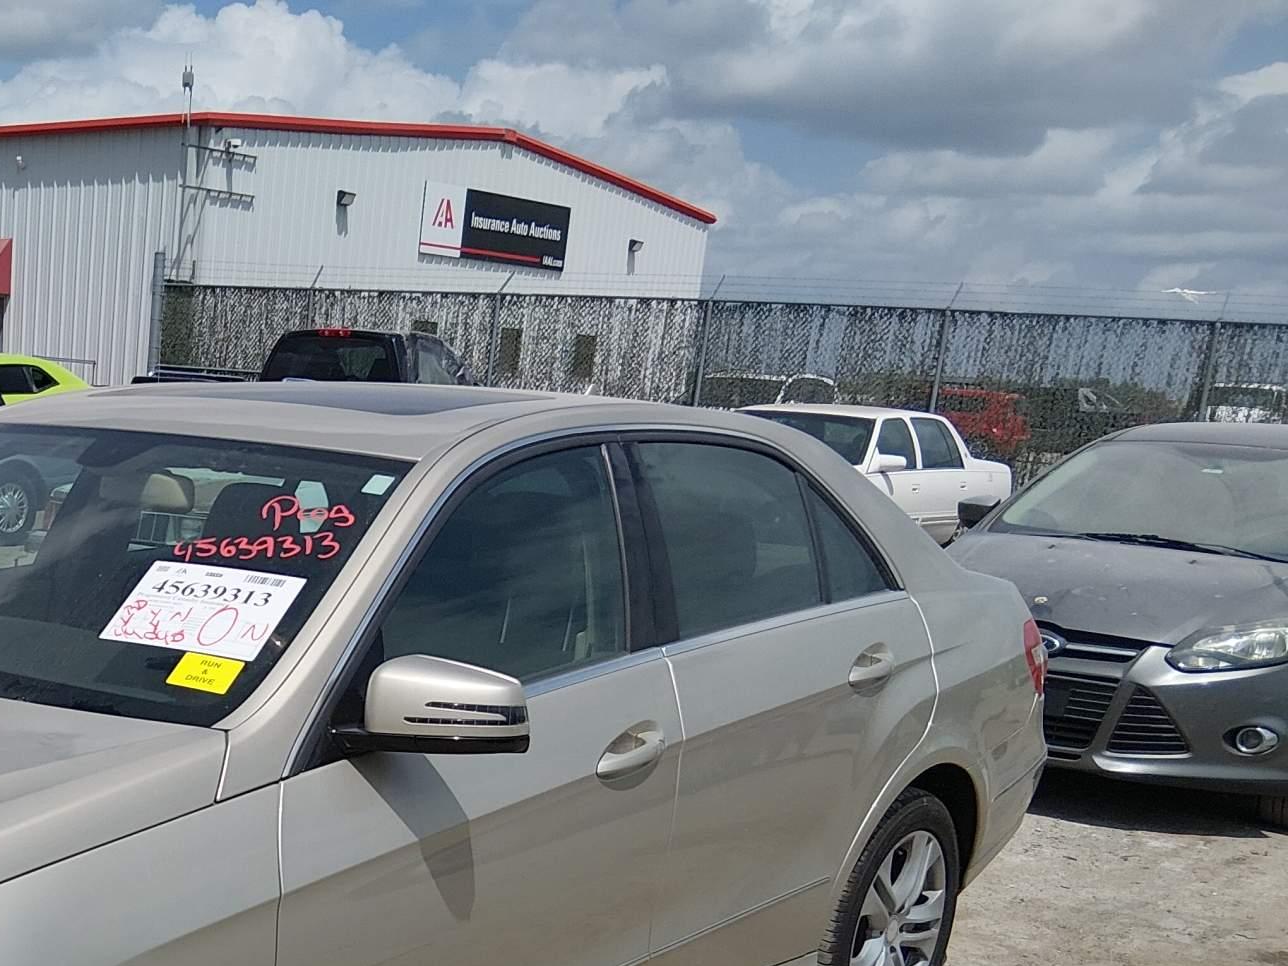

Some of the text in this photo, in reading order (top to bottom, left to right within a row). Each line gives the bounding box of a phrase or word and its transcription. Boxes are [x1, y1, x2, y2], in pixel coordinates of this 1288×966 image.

[471, 212, 562, 241] Insurance Auto Auctions
[173, 531, 340, 562] 45639313
[151, 579, 272, 607] 45639313
[200, 659, 223, 669] RUN
[184, 674, 216, 686] DRIVE
